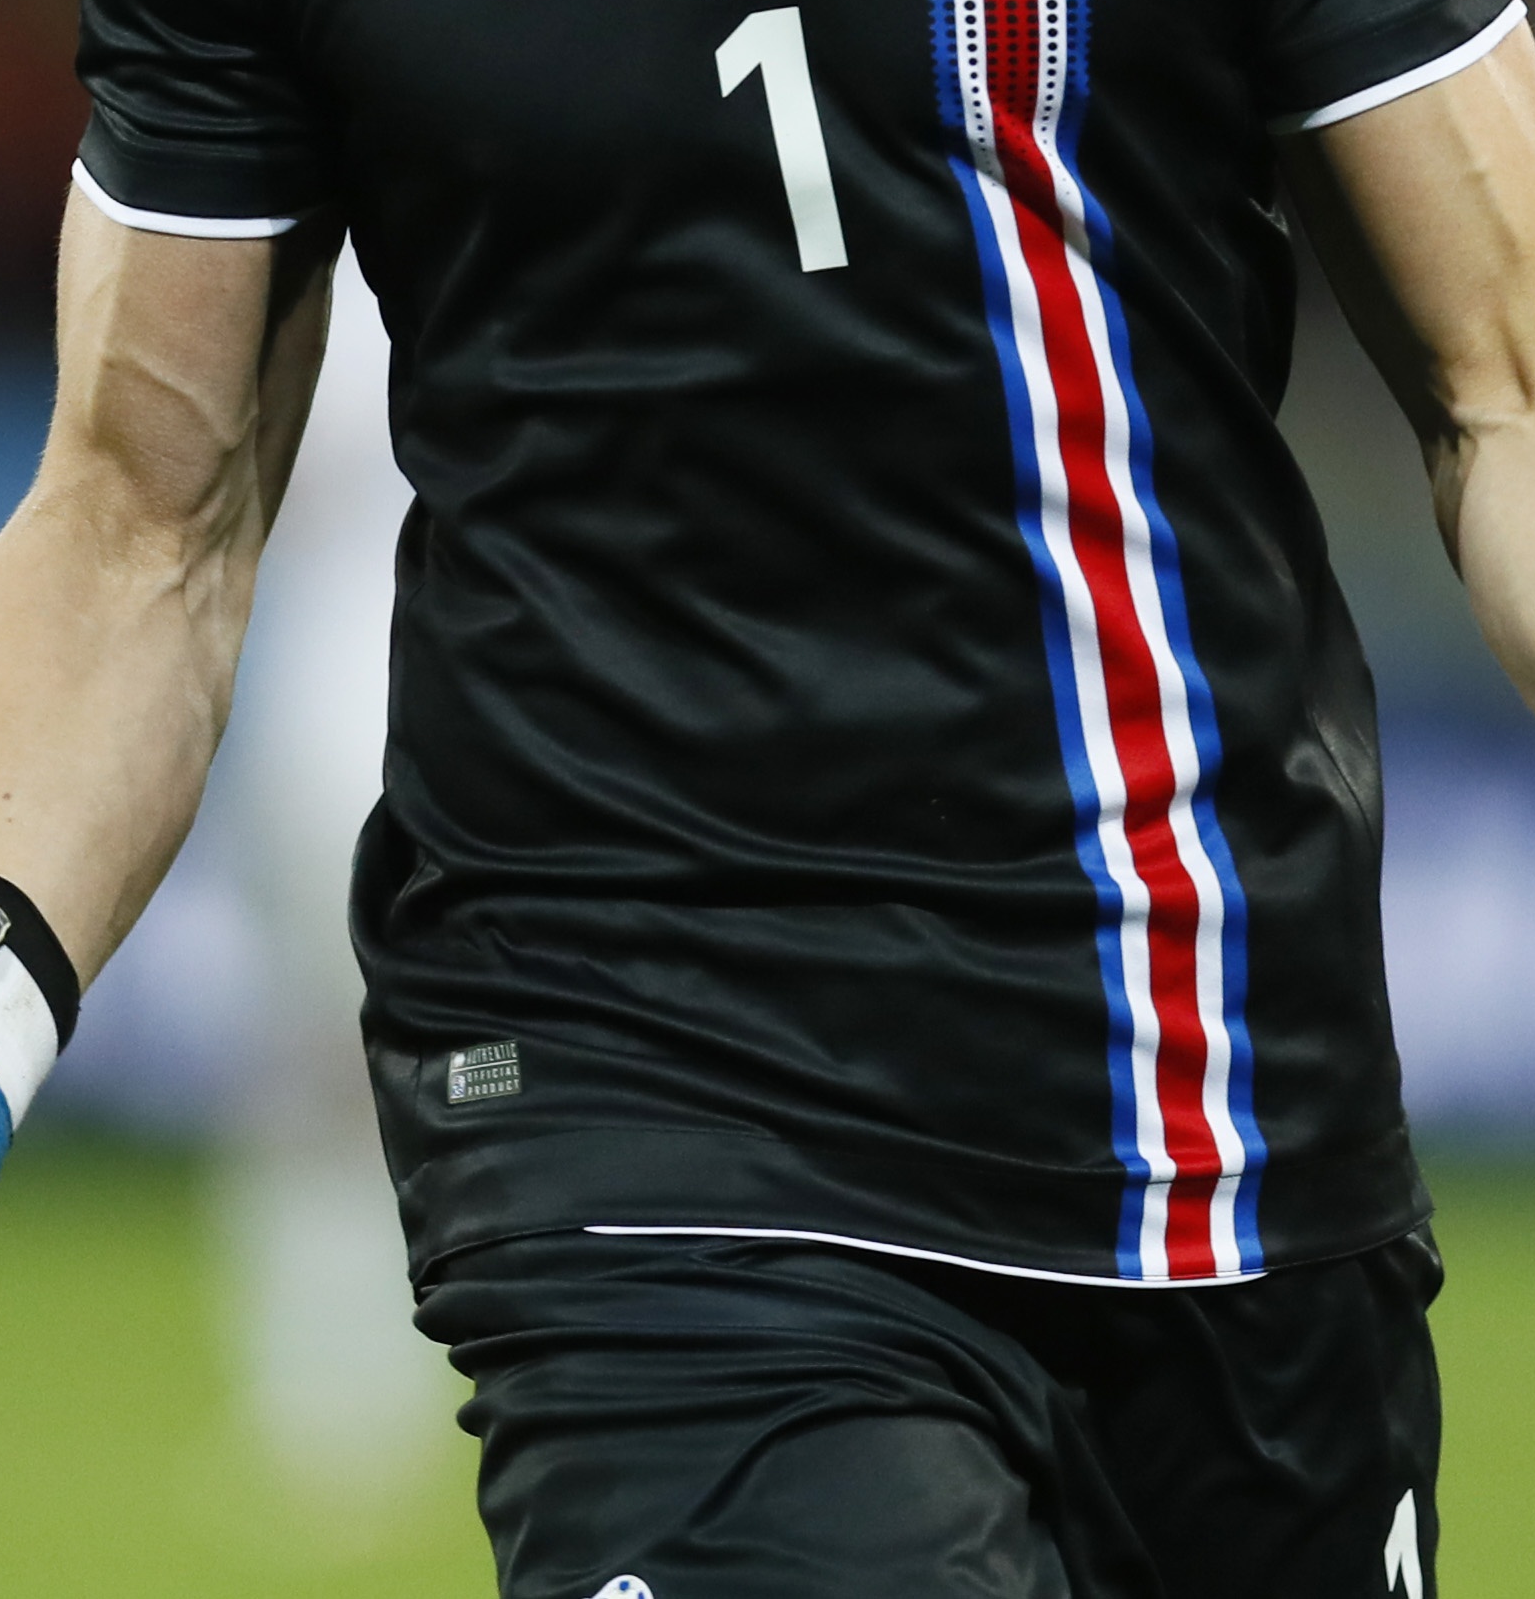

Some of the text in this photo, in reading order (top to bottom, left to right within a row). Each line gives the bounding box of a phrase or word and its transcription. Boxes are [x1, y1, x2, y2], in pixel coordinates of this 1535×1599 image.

[716, 6, 849, 273] 1
[467, 1065, 519, 1082] OFFICIAL
[468, 1079, 519, 1096] PRODUCT
